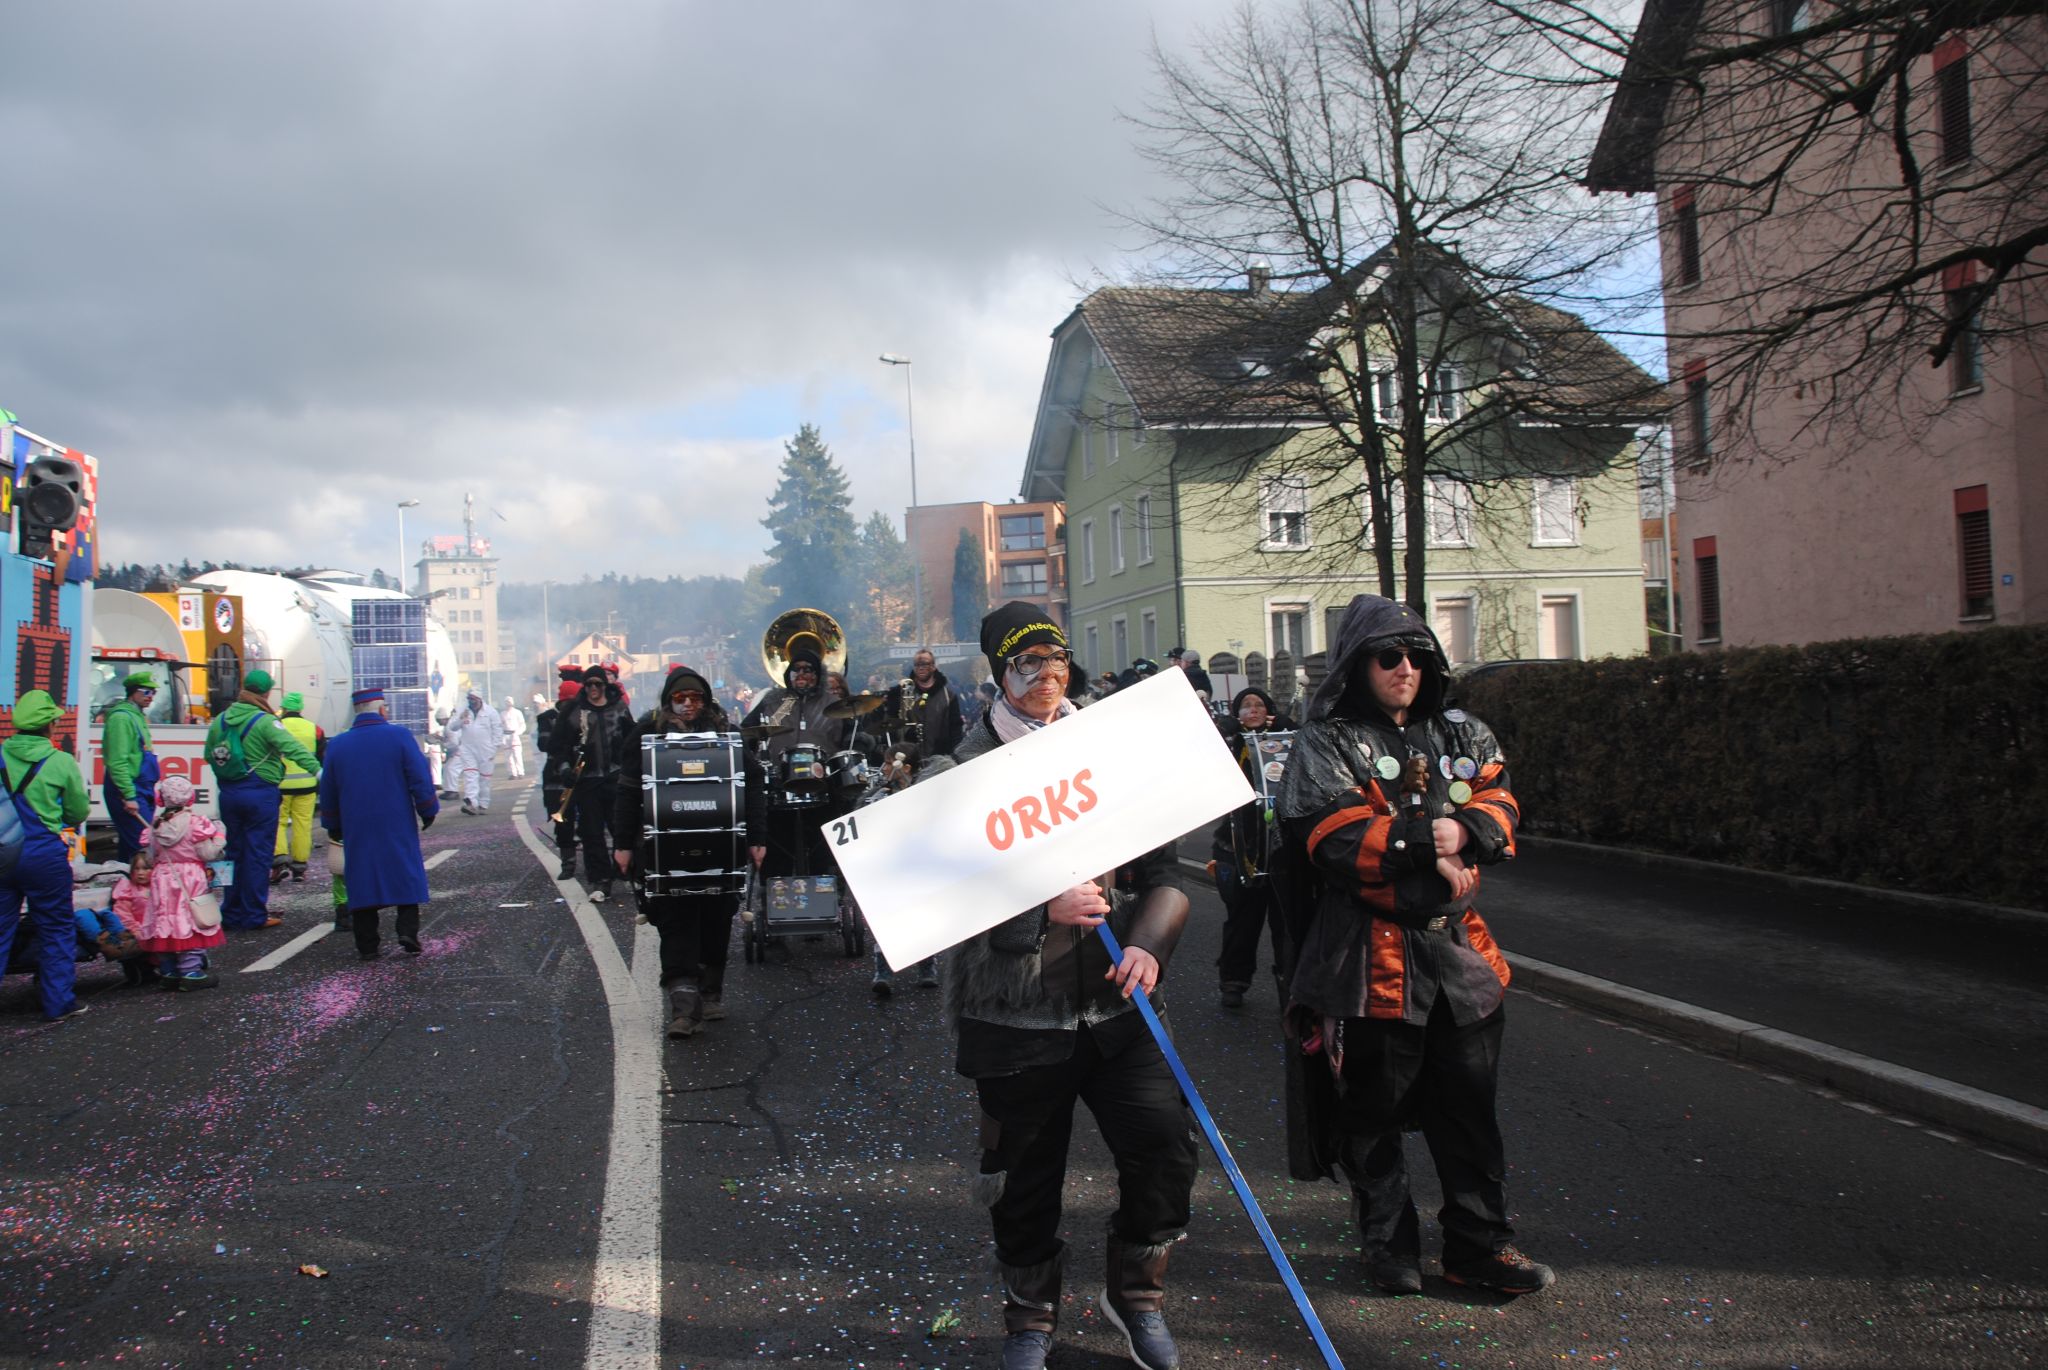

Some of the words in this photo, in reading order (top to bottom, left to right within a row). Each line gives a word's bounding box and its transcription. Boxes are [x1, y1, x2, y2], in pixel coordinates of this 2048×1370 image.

[682, 800, 718, 811] YAMAHA
[985, 768, 1098, 851] ORKS
[832, 816, 859, 846] 21
